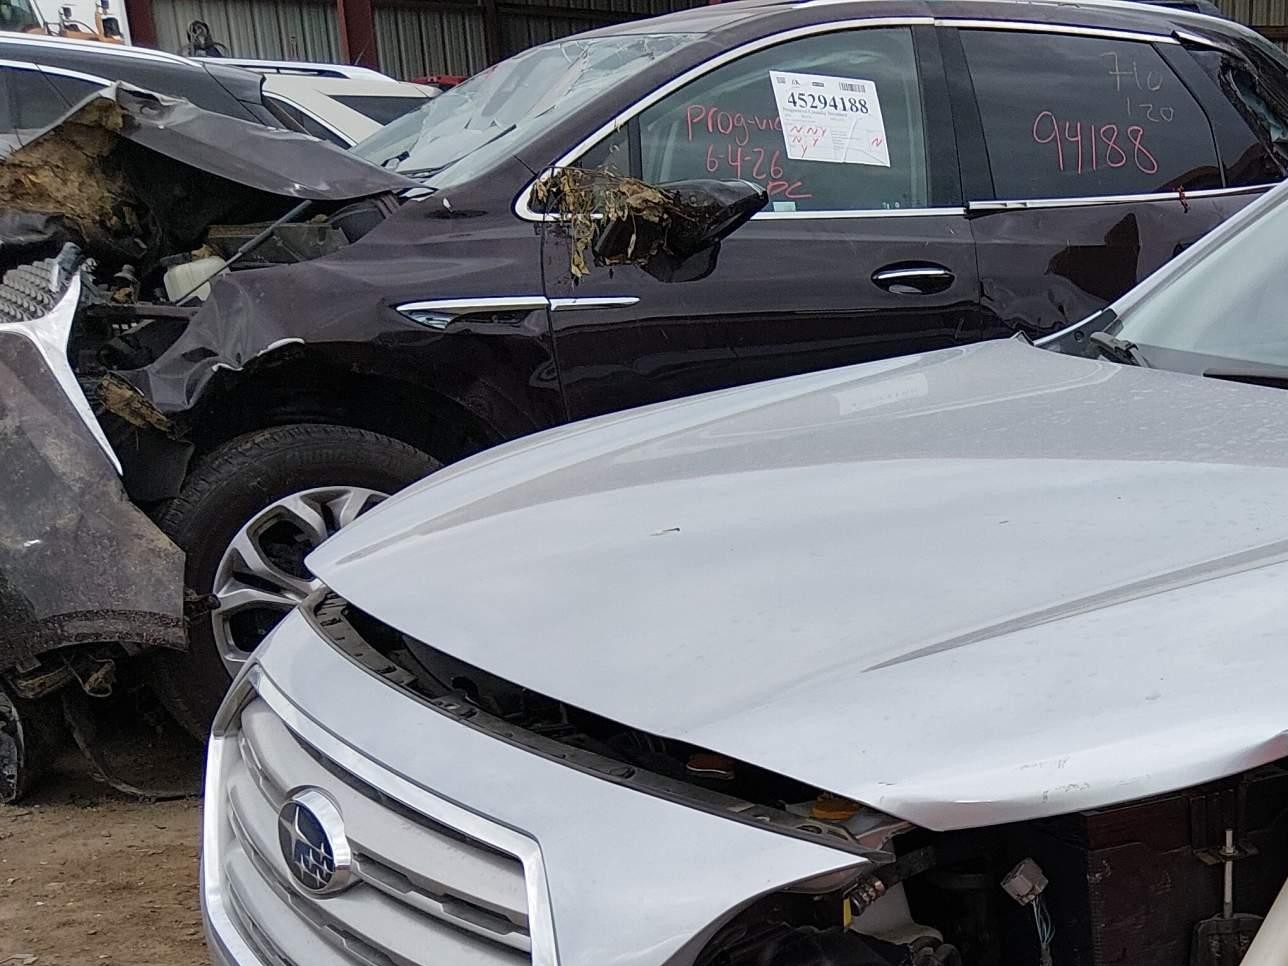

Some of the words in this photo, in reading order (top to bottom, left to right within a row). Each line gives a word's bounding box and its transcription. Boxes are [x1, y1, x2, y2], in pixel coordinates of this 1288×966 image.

[787, 91, 869, 114] 45294188
[1033, 111, 1158, 174] 94188
[706, 144, 784, 181] 6-4-26
